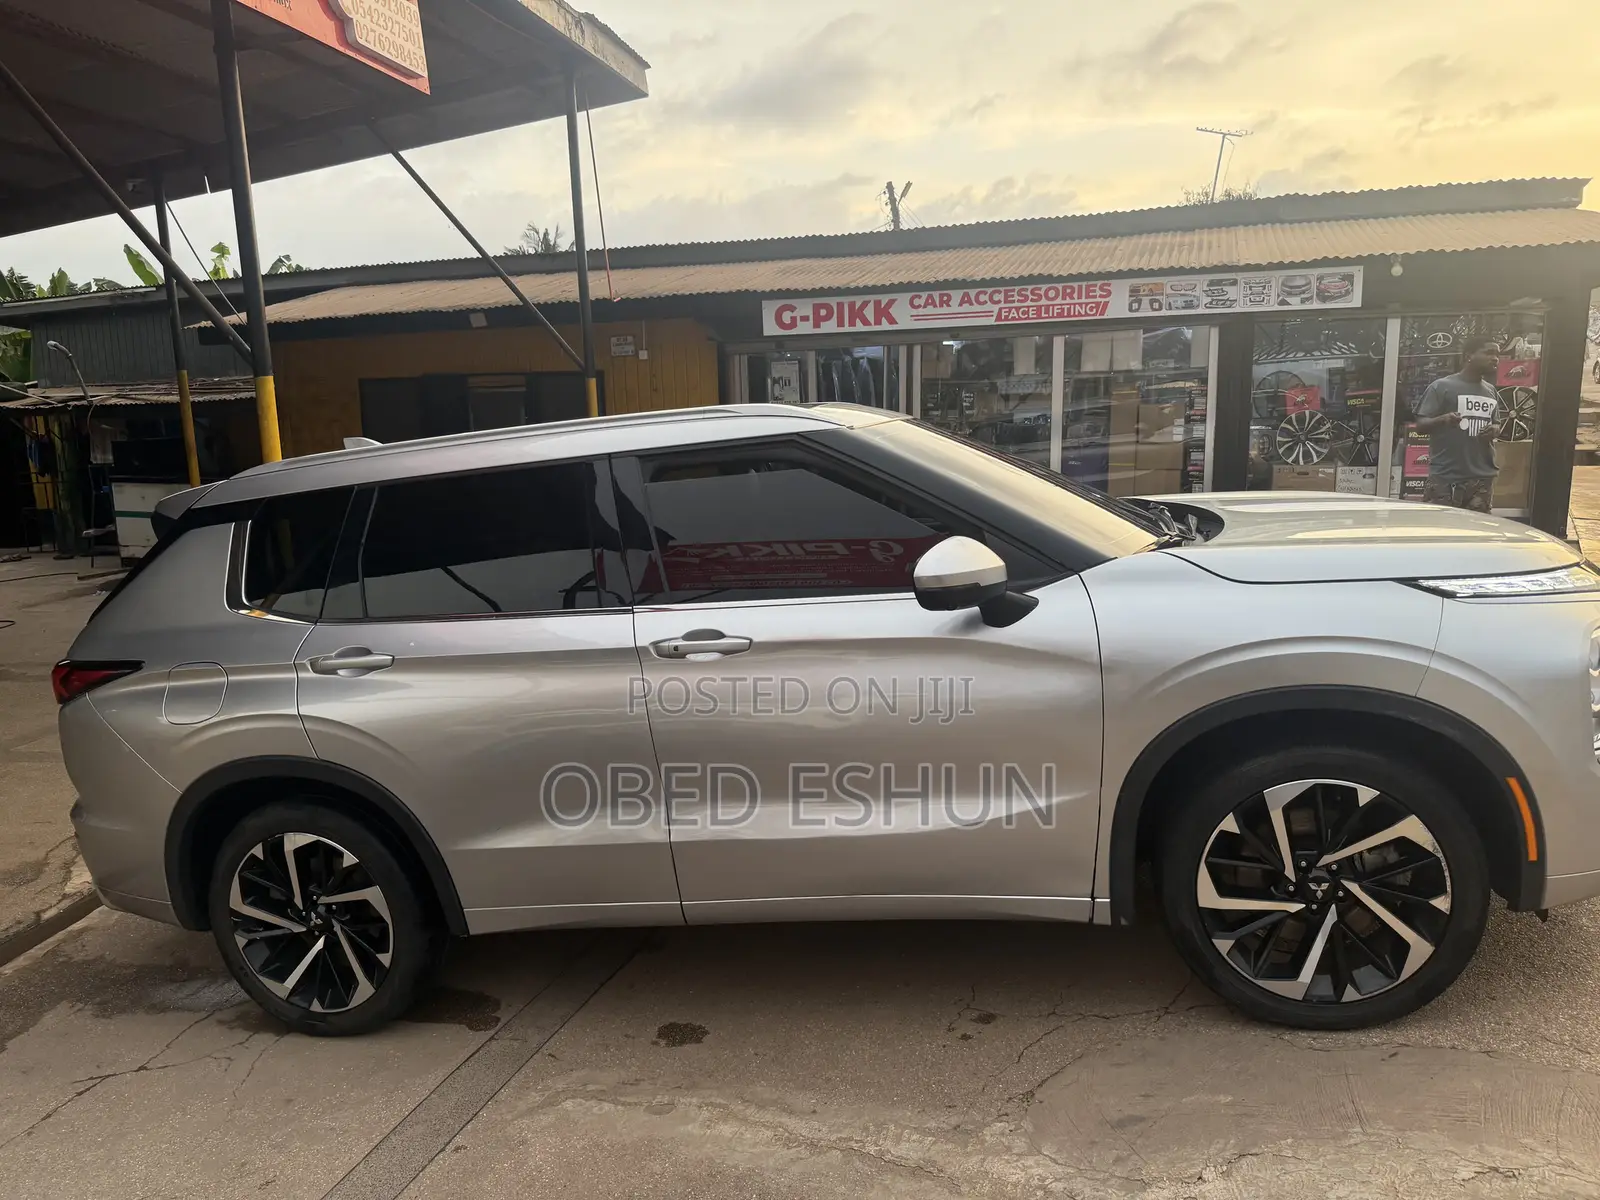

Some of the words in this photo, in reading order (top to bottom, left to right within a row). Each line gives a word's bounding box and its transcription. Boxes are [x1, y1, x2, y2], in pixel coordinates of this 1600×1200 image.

[355, 20, 426, 73] 0276298453
[909, 293, 952, 310] CAR
[958, 282, 1112, 307] ACCESSORIES
[1001, 306, 1038, 320] FACE
[1041, 303, 1097, 318] LIFTING
[774, 297, 899, 331] G-PIKK
